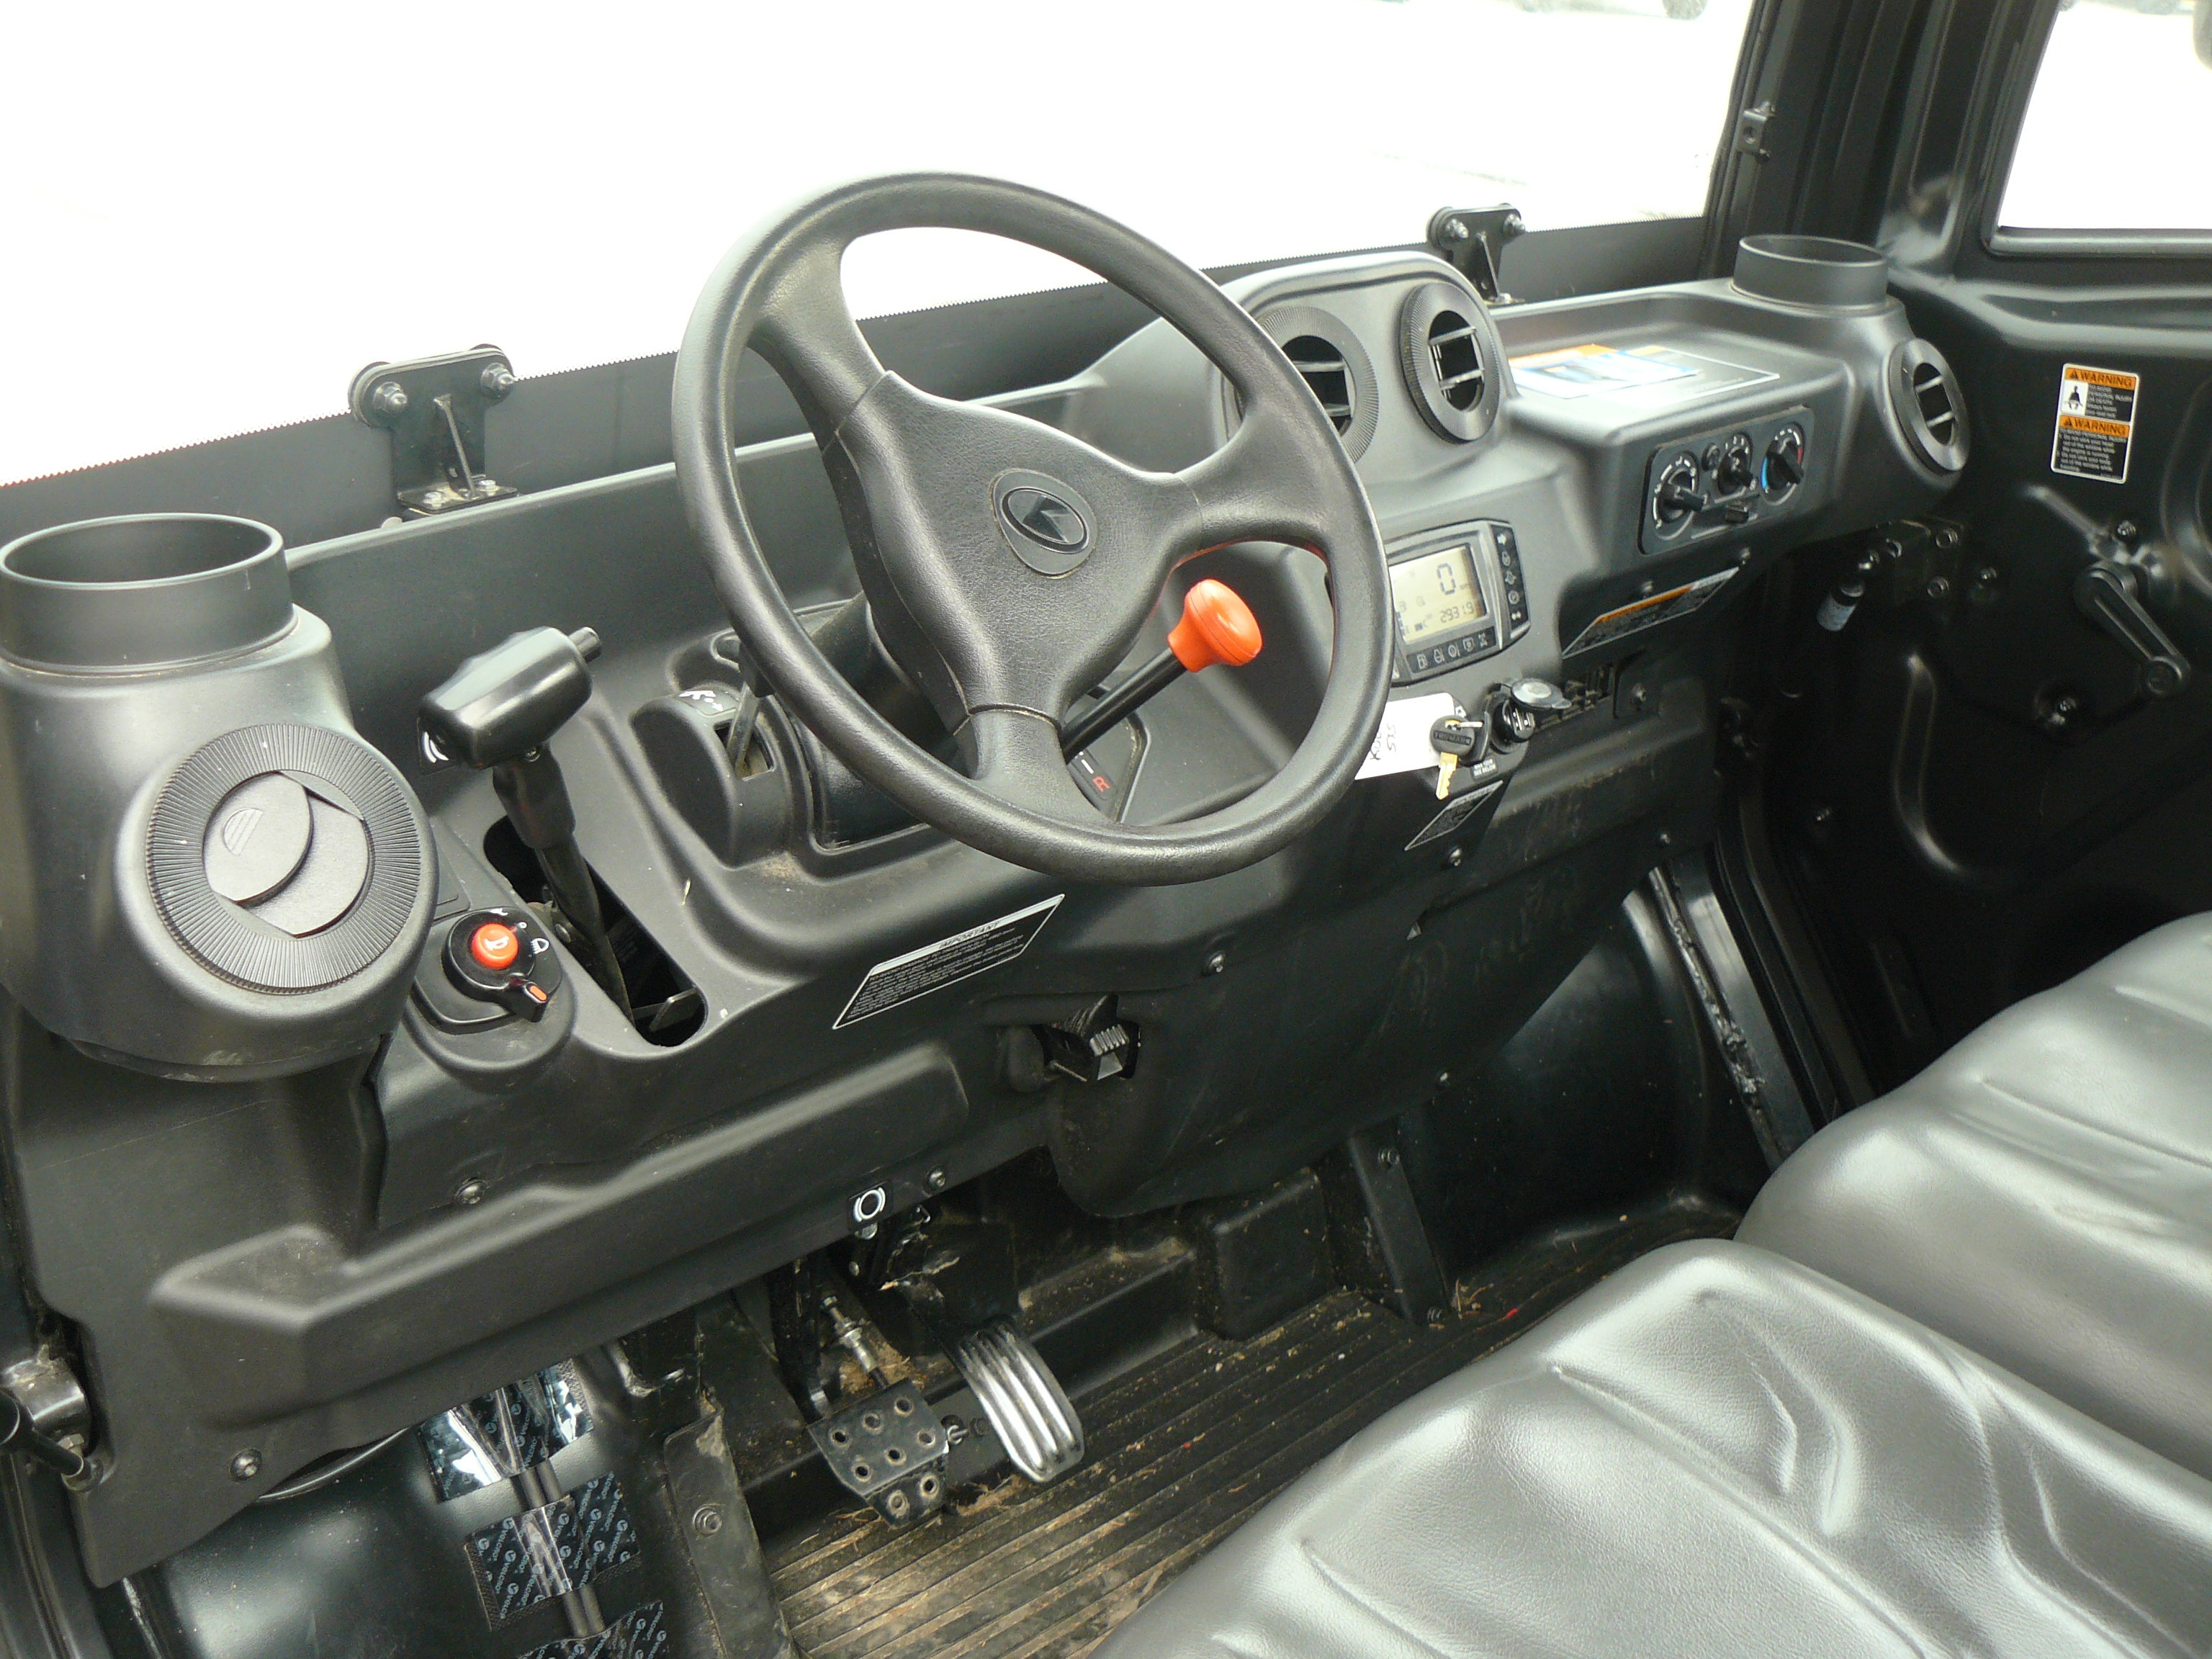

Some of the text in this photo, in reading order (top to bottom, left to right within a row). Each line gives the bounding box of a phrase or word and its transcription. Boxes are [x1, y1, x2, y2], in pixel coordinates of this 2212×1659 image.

[2081, 372, 2132, 387] WARNING
[2074, 418, 2126, 434] WARNING
[1437, 562, 1456, 595] 0
[1092, 775, 1110, 793] R
[939, 921, 1002, 949] IMPORTANT
